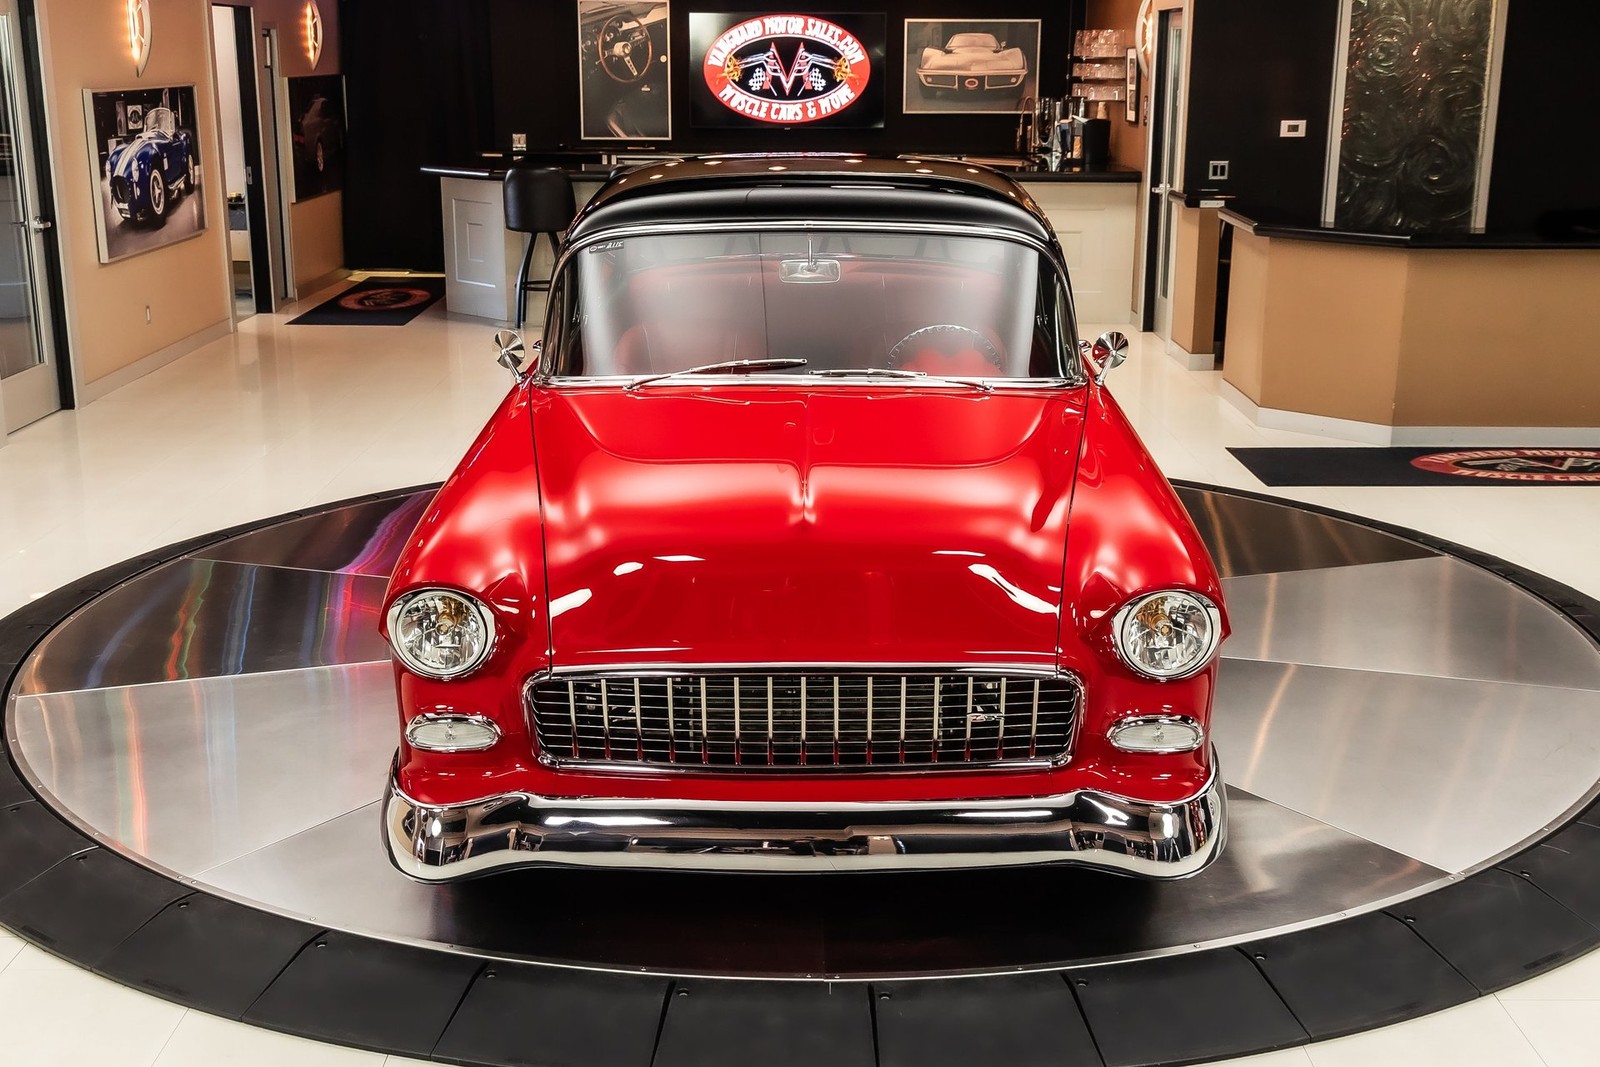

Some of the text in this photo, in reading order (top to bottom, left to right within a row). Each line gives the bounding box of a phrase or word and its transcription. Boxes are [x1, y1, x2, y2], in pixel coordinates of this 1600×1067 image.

[707, 16, 865, 66] VANGUARD MOTOR SALES.COM
[718, 83, 856, 121] MUSCLE CARS & MORE
[1521, 449, 1597, 457] MOTOR
